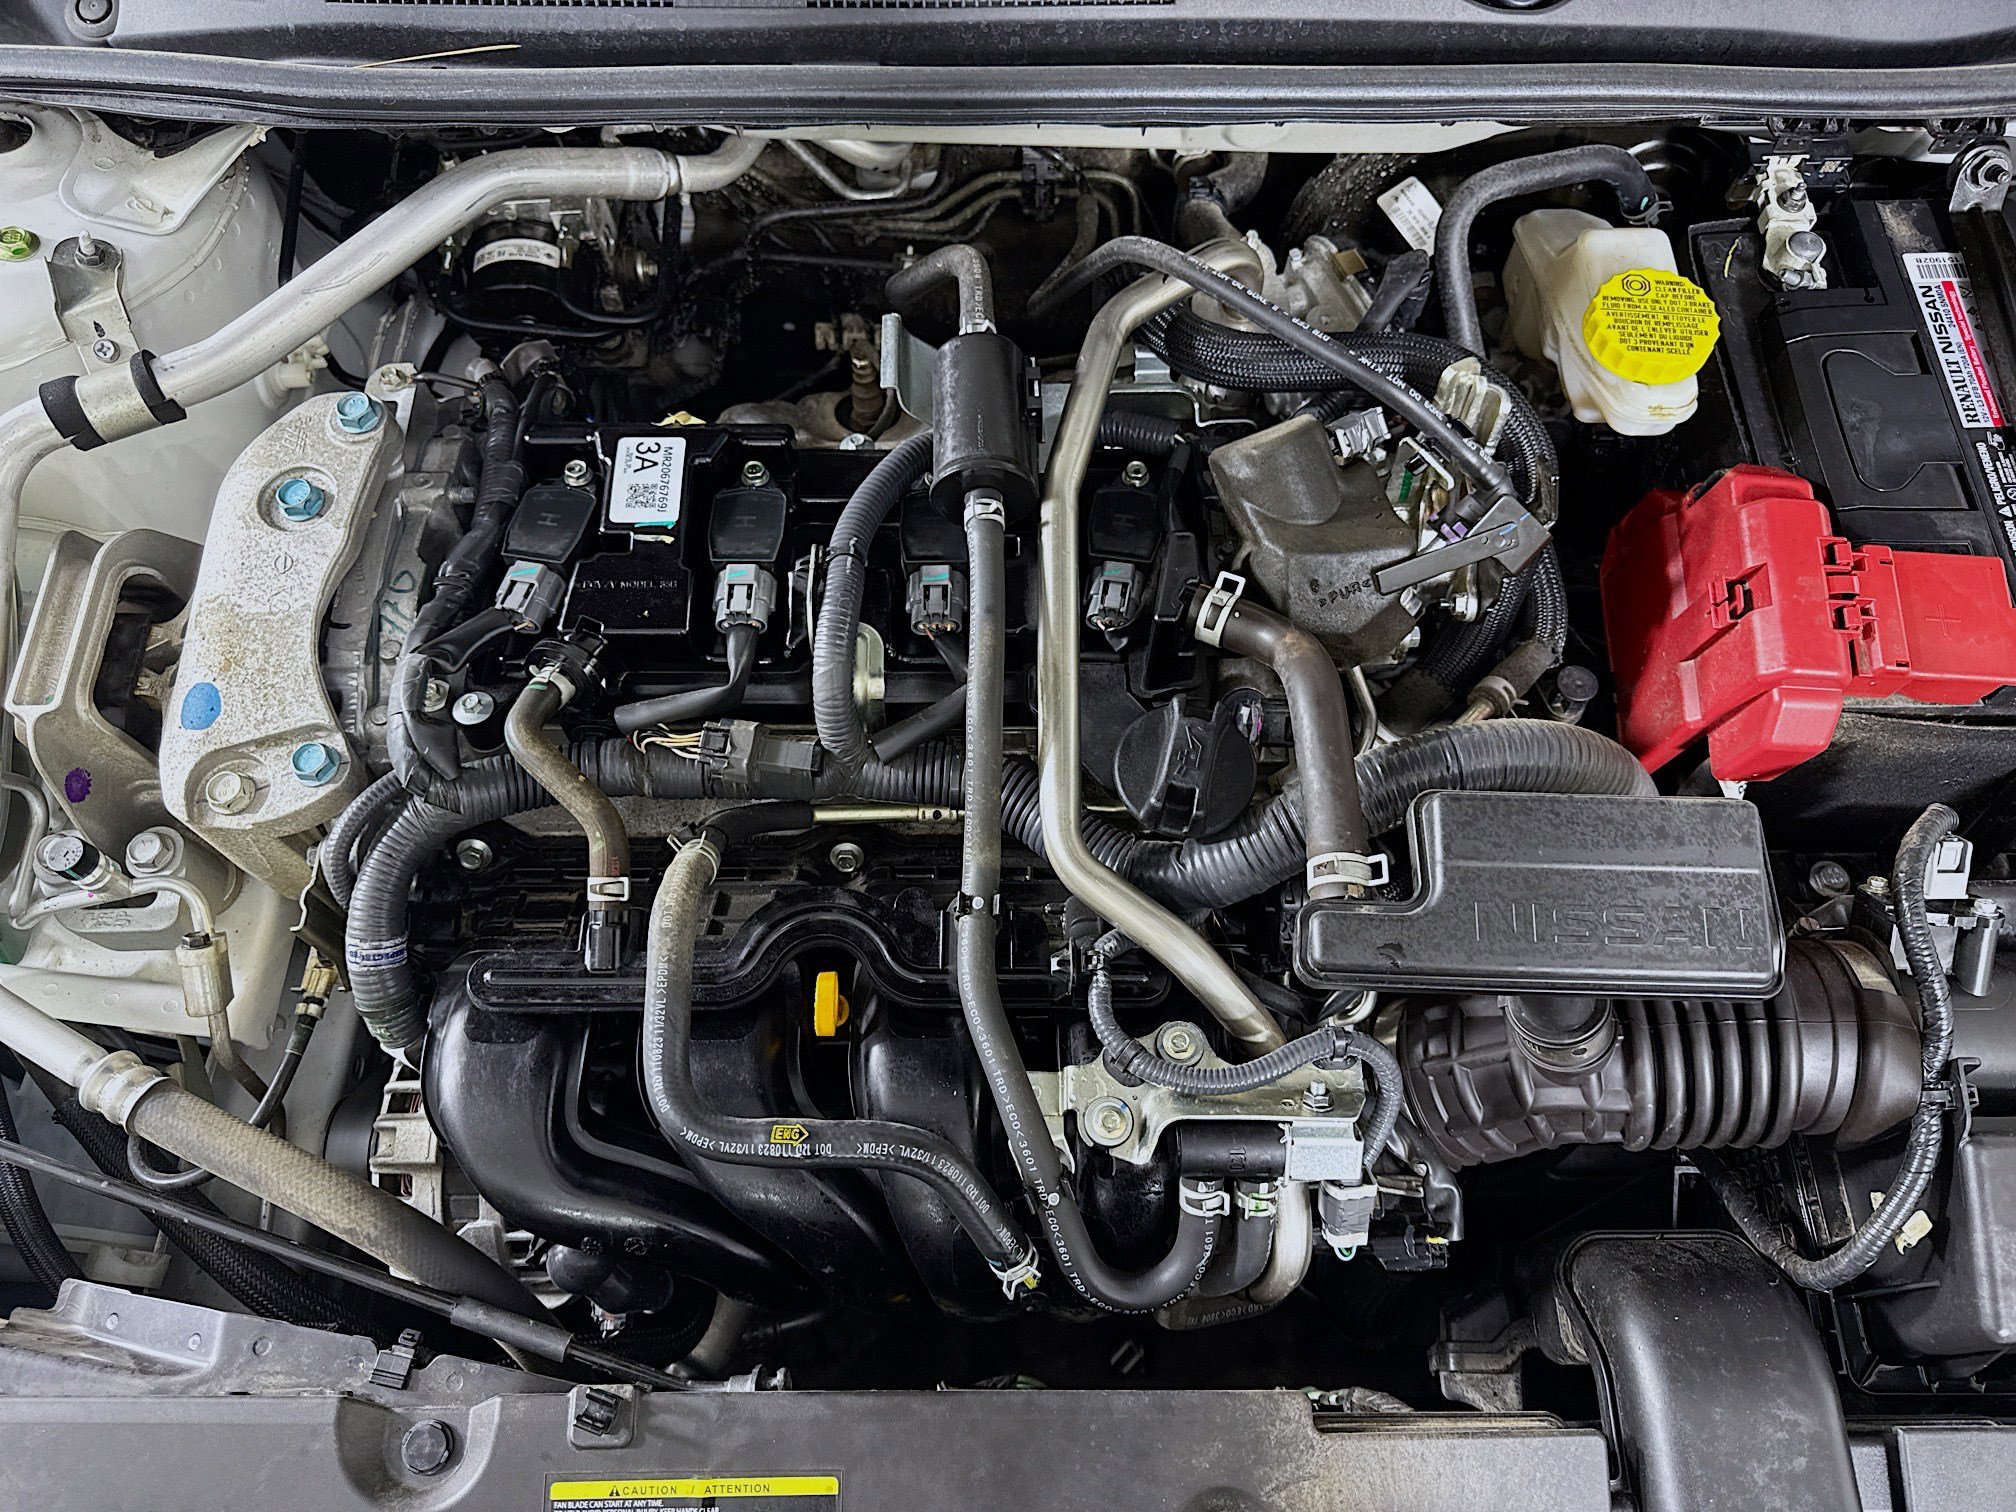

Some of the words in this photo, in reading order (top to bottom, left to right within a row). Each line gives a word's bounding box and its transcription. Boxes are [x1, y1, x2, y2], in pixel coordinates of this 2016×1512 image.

[1947, 290, 1965, 321] technology
[1654, 321, 1699, 329] REMPLISSAGE
[1663, 315, 1696, 323] NETTOYER
[1918, 284, 1956, 353] NISSAN
[1619, 331, 1657, 339] SEULEMENT
[1958, 320, 1973, 341] Special
[1626, 345, 1664, 353] CONTENANT
[1640, 339, 1677, 347] PROVENANT
[1967, 345, 1982, 365] Battery
[1358, 356, 1383, 374] KINK
[1386, 374, 1407, 390] NOT
[1975, 366, 1990, 389] Flooded
[1408, 388, 1422, 402] DO
[1944, 359, 1981, 423] RENAULT
[633, 442, 661, 474] 3A
[657, 446, 673, 513] MR20676769J
[1975, 442, 2007, 505] PELIGRO/VENENO
[1318, 578, 1372, 608] >PUR<
[1474, 900, 1754, 950] NISSAN
[653, 998, 667, 1034] 11/32VL
[652, 1037, 663, 1072] 110823
[656, 1093, 670, 1113] DOT
[679, 1127, 715, 1150] >EPDM<
[719, 1141, 755, 1155] 11/32VL
[757, 1143, 792, 1156] 110823
[815, 1143, 831, 1155] DOT
[856, 1143, 895, 1155] >EPDM<
[899, 1145, 936, 1164] 11/32VL
[937, 1158, 966, 1187] 110823
[976, 1200, 990, 1214] DOT
[623, 1485, 678, 1496] CAUTION
[704, 1484, 770, 1494] ATTENTION
[553, 1501, 566, 1509] FAN
[567, 1501, 588, 1509] BLADE
[589, 1501, 603, 1509] CAN
[603, 1500, 623, 1508] START
